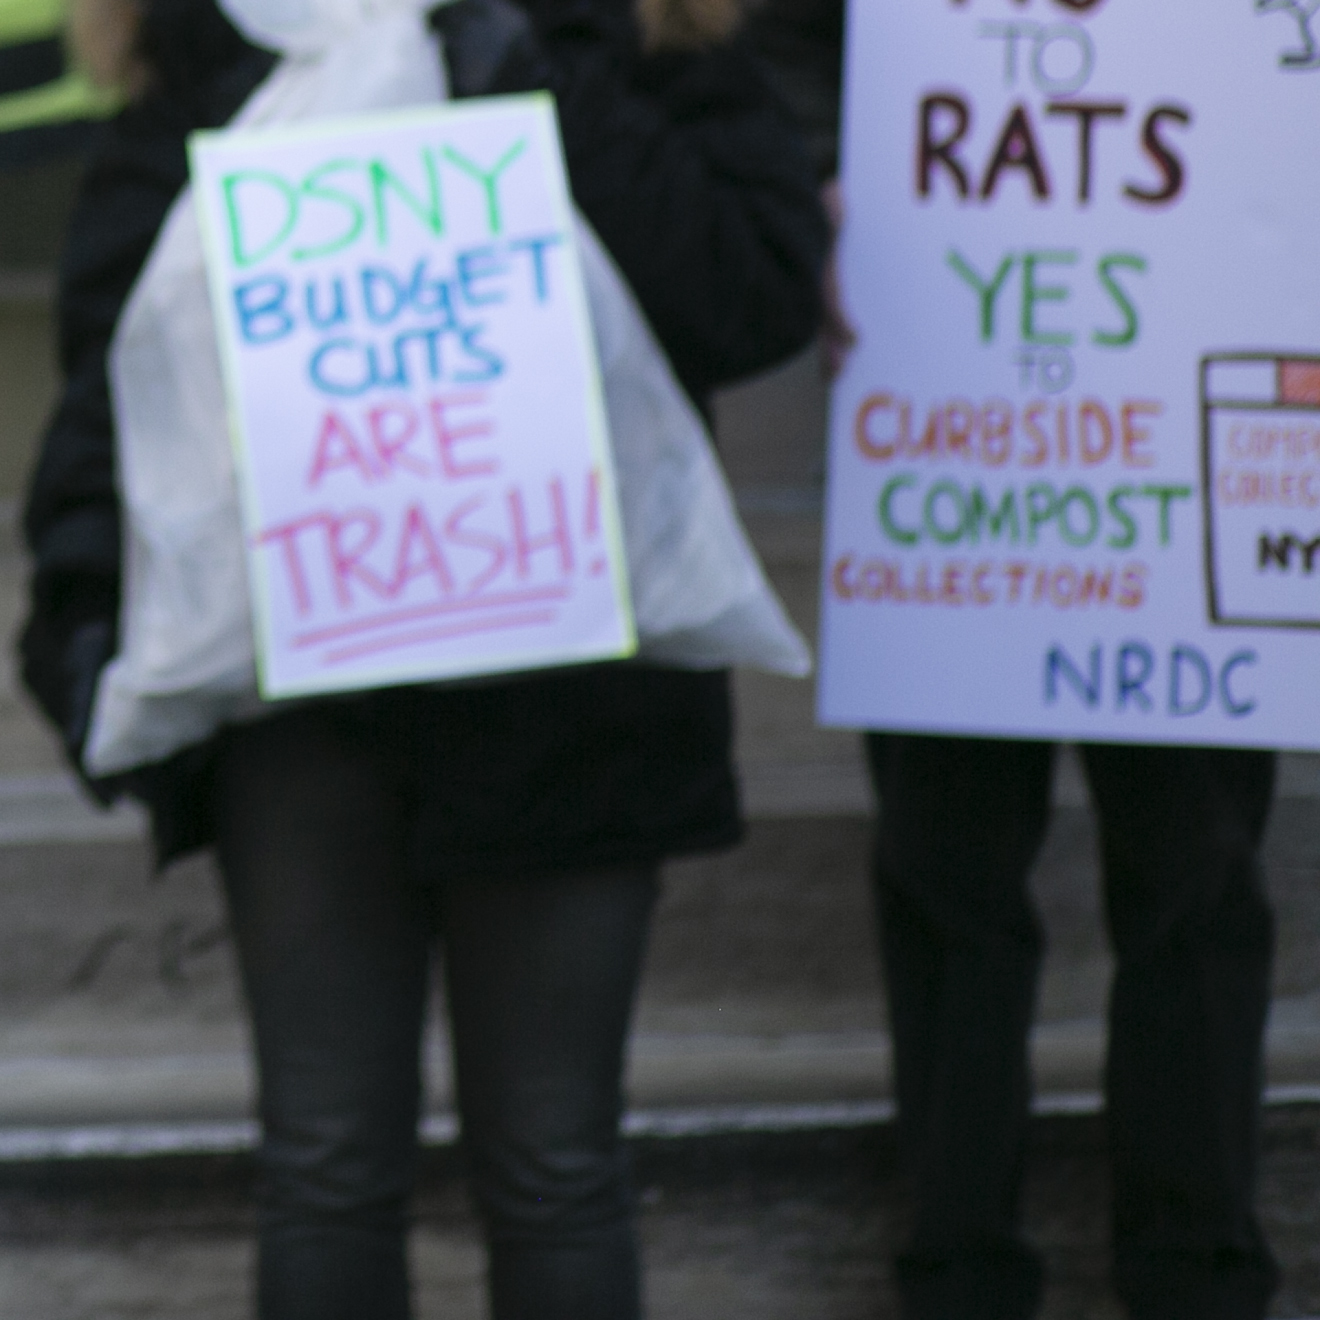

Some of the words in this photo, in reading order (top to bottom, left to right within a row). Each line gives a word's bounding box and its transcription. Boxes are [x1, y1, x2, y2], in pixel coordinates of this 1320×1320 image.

[976, 18, 1095, 96] TO
[915, 91, 1193, 207] RATS
[220, 138, 528, 269] DSNY
[233, 232, 564, 348] BUDGET
[946, 247, 1149, 347] YES
[308, 323, 506, 398] CUTS
[1013, 349, 1075, 393] TO
[306, 393, 503, 489] ARE
[855, 393, 1164, 468] CURBSIDE
[253, 470, 609, 616] TRASH!
[877, 475, 1193, 548] COMPOST
[832, 553, 1150, 608] COLLECTIONS
[1044, 639, 1258, 718] NRDC
